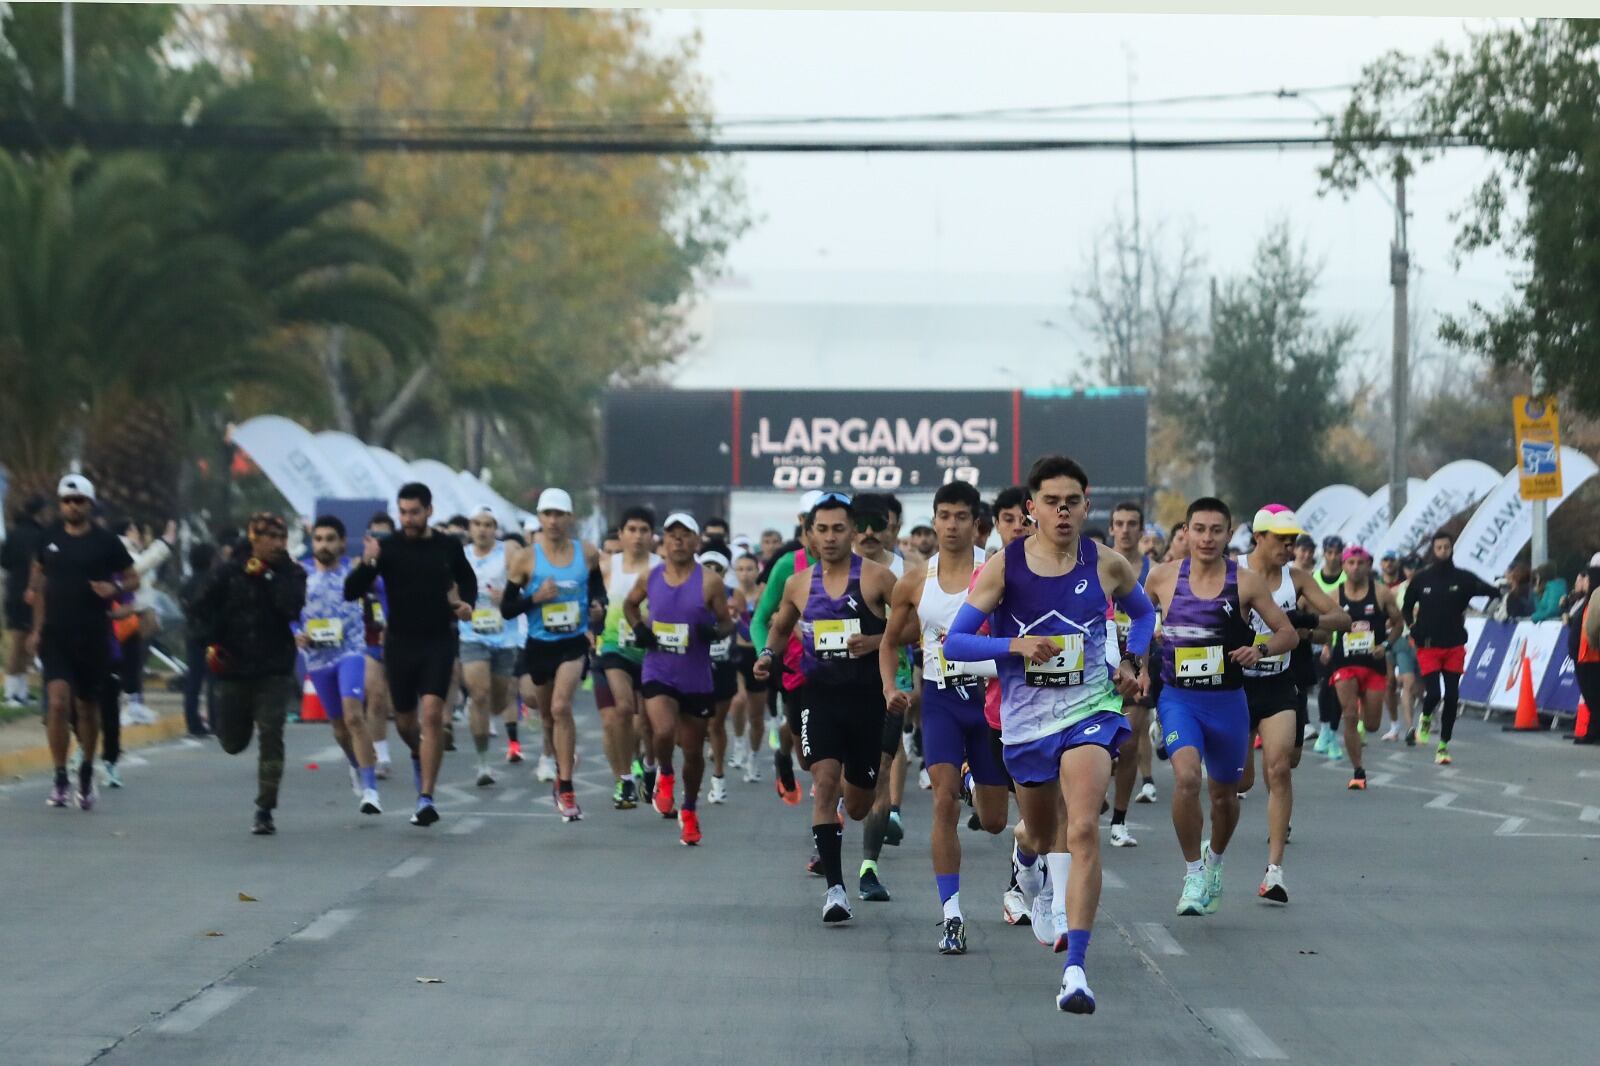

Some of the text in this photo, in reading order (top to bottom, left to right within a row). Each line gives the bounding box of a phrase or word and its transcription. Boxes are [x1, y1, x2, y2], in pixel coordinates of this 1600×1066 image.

[751, 417, 999, 457] ¡LARGAMOS!
[773, 466, 826, 488] 00
[850, 466, 902, 488] 00
[1470, 489, 1523, 564] HUAW
[819, 637, 827, 645] M
[1056, 657, 1065, 667] 2
[946, 663, 955, 672] M
[1180, 663, 1208, 672] M 6
